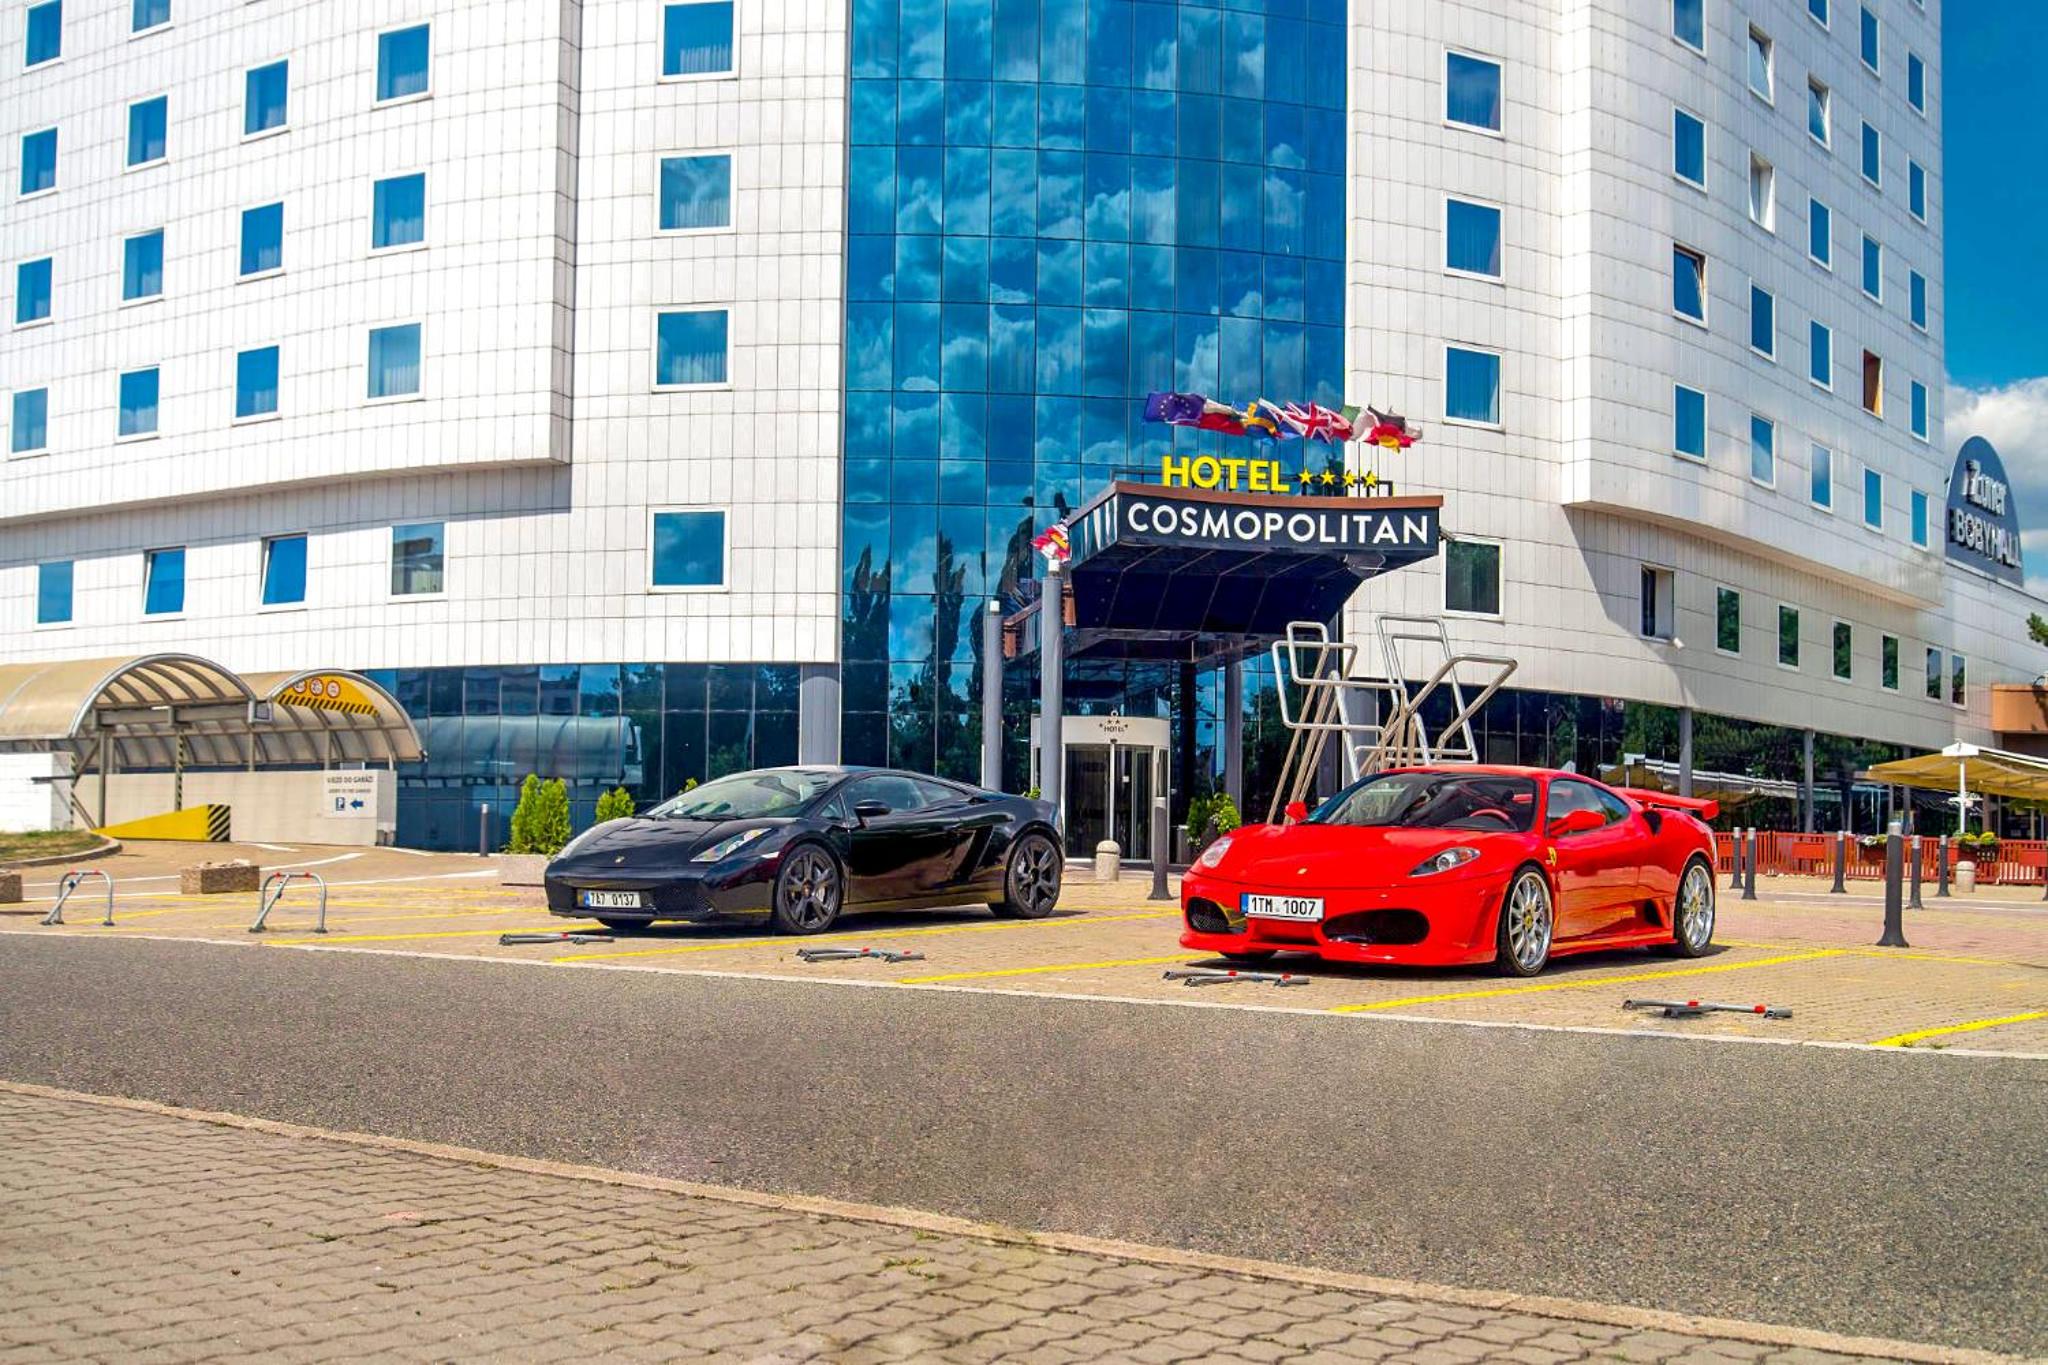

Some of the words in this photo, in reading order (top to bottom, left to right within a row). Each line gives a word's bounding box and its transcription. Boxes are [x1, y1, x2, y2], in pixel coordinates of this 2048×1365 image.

[1162, 455, 1290, 492] HOTEL
[1127, 503, 1428, 545] COSMOPOLITAN
[611, 894, 634, 906] 0137
[1251, 897, 1273, 913] 1TM
[1283, 900, 1316, 915] 1007
